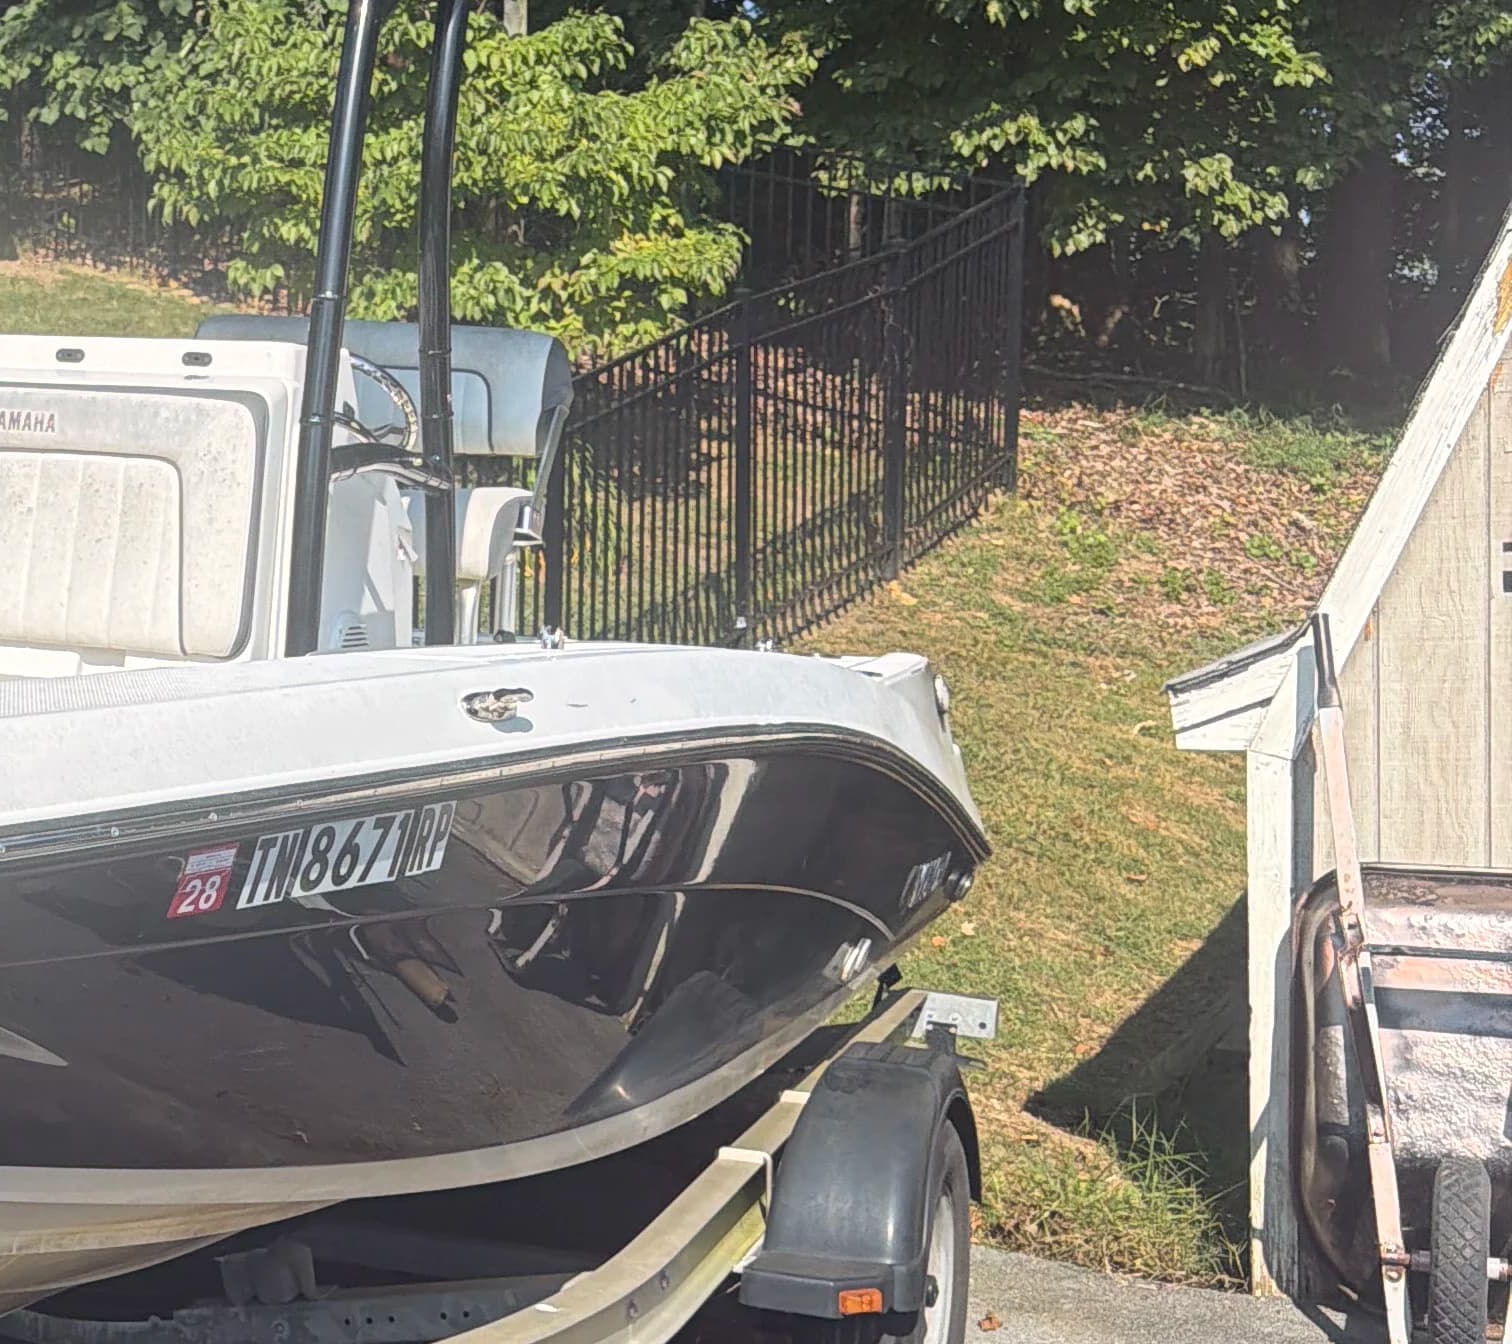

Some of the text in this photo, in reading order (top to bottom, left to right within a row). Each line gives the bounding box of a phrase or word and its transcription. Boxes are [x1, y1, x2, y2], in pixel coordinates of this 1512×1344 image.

[247, 833, 300, 903] TN
[301, 813, 411, 892] 8671
[176, 875, 221, 913] 28
